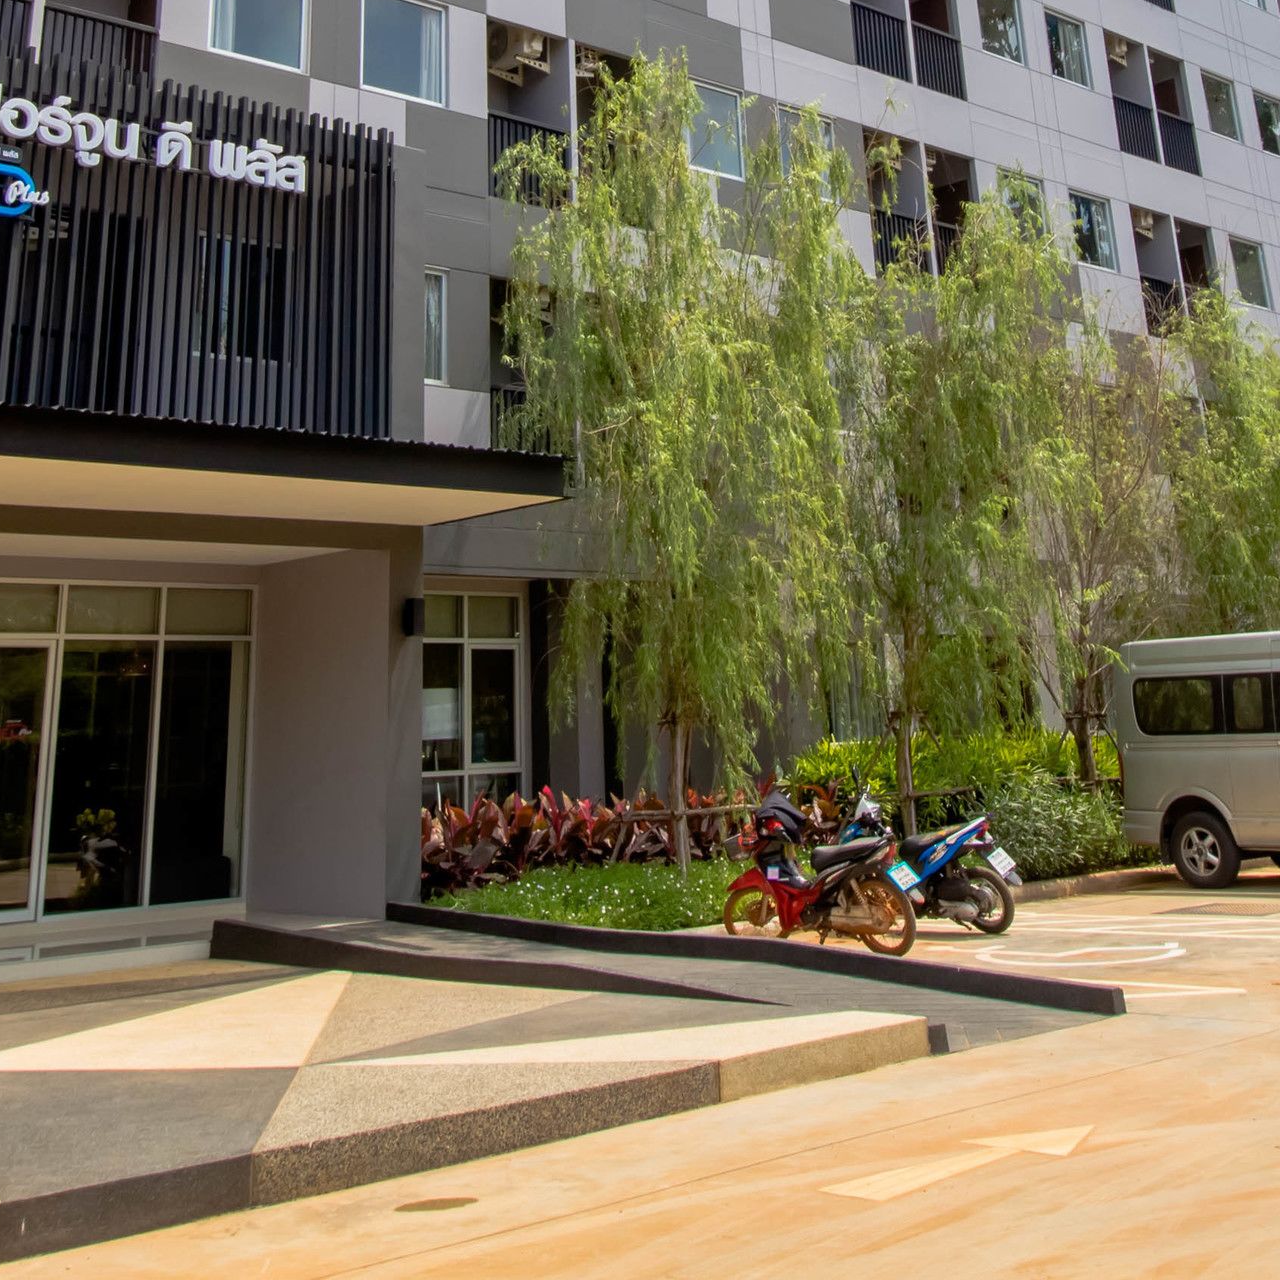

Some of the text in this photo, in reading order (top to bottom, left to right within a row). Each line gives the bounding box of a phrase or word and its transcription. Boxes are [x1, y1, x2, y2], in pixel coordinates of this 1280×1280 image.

[156, 121, 193, 170] ดี
[208, 138, 306, 193] พลัส
[4, 180, 50, 205] Plus
